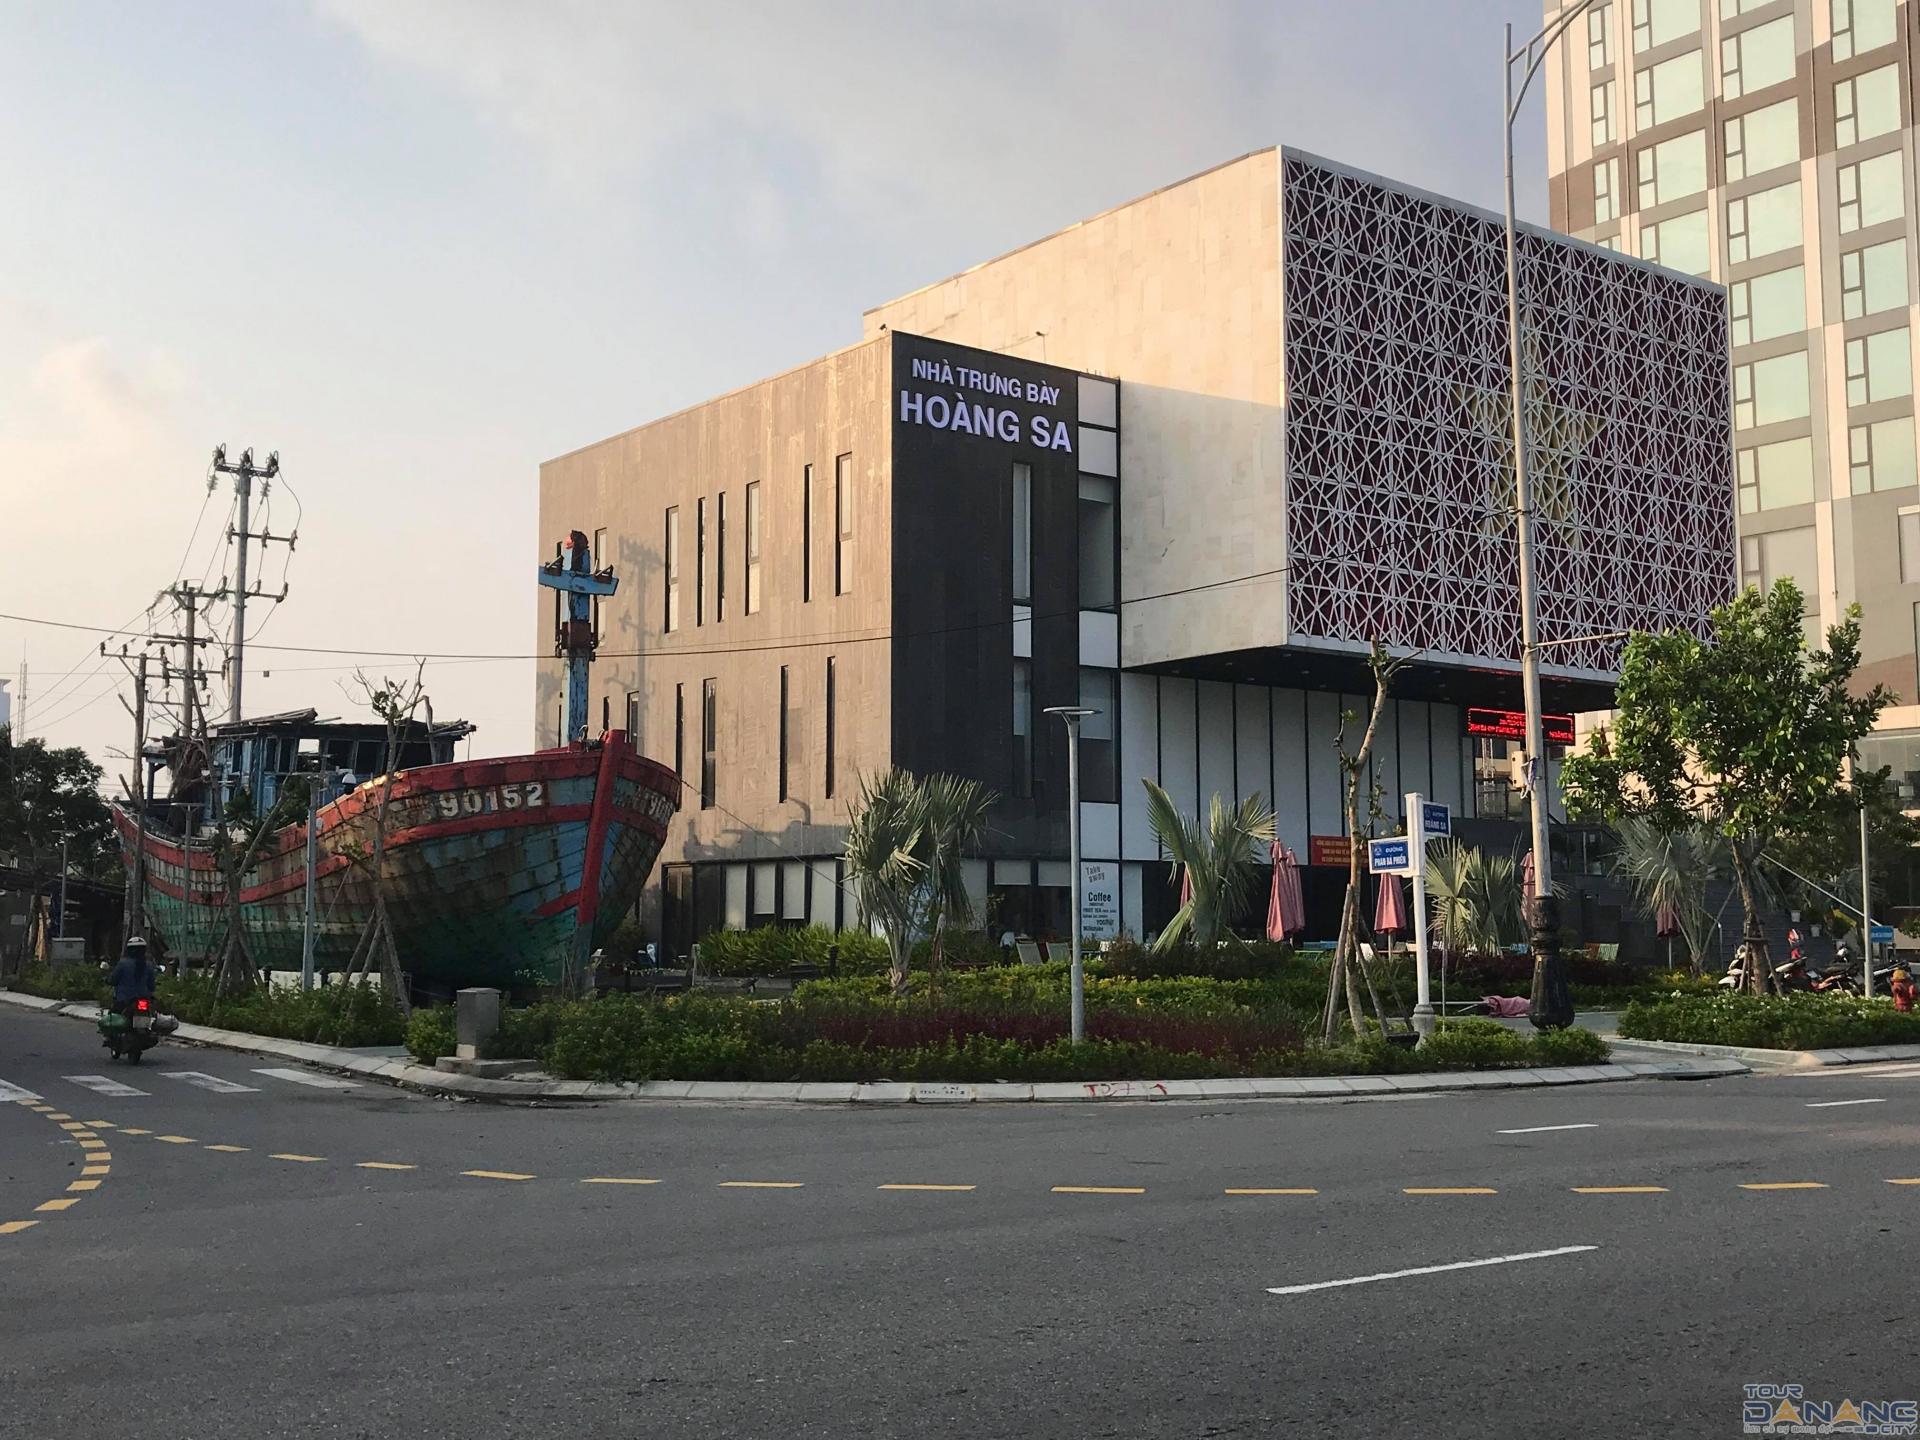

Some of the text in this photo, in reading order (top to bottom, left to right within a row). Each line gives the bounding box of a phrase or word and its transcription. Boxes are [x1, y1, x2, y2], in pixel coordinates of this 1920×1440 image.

[912, 358, 1060, 406] NHÀ TRƯNG BÀY
[900, 390, 1072, 453] HOÀNG SA
[438, 781, 544, 817] 90152
[1088, 892, 1112, 902] Coffee
